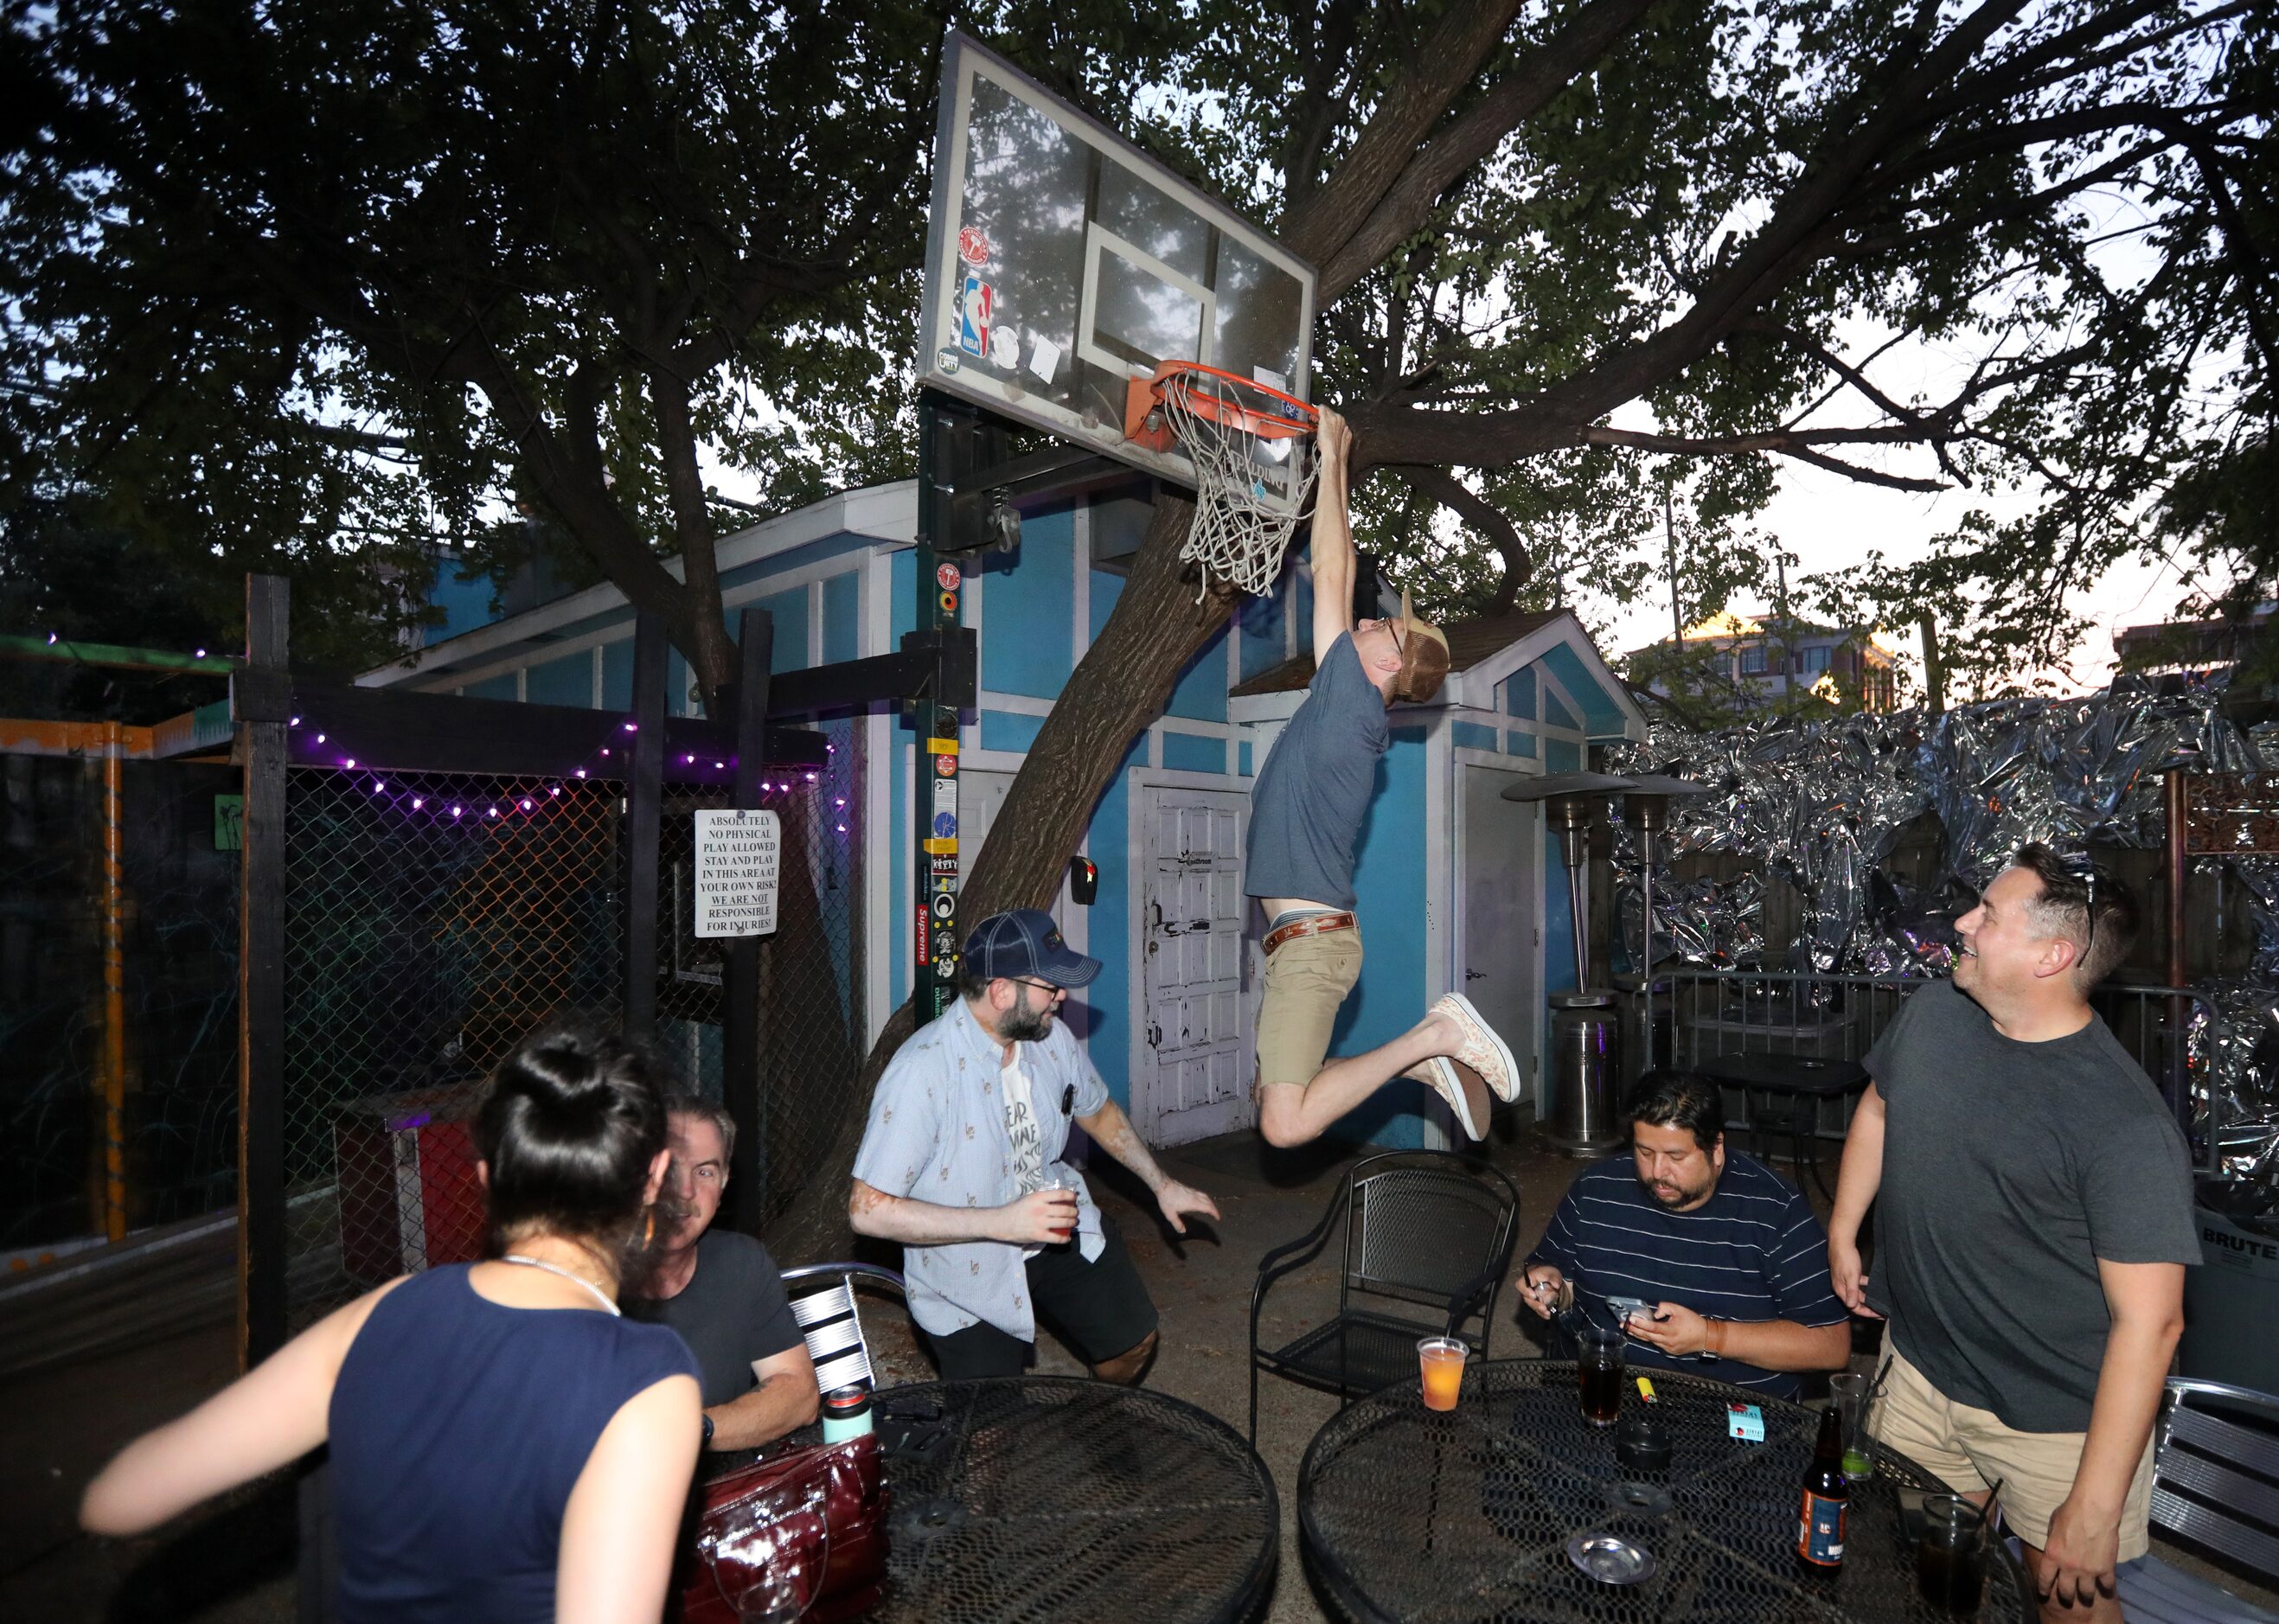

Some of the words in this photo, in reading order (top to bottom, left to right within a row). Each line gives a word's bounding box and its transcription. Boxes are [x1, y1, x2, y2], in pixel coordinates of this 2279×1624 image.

[963, 336, 979, 352] NBA
[710, 816, 771, 826] ABSOLUTELY
[709, 830, 723, 839] NO
[726, 829, 771, 839] PHYSICAL
[704, 843, 729, 853] PLAY
[731, 842, 776, 852] ALLOWED
[705, 857, 729, 866] STAY
[731, 856, 750, 865] AND
[753, 855, 775, 864] PLAY
[703, 870, 713, 879] IN
[715, 869, 739, 879] THIS
[740, 868, 765, 878] AREA
[701, 883, 728, 892] YOUR
[731, 882, 753, 891] OWN
[757, 880, 777, 890] RISK!
[712, 896, 727, 905] WE
[730, 895, 749, 904] ARE
[752, 894, 769, 904] NOT
[708, 906, 770, 918] RESPONSIBLE
[707, 923, 727, 931] FOR
[730, 919, 771, 930] INJURIES!
[1005, 1102, 1028, 1128] EAR
[2204, 1227, 2277, 1260] BRUTE
